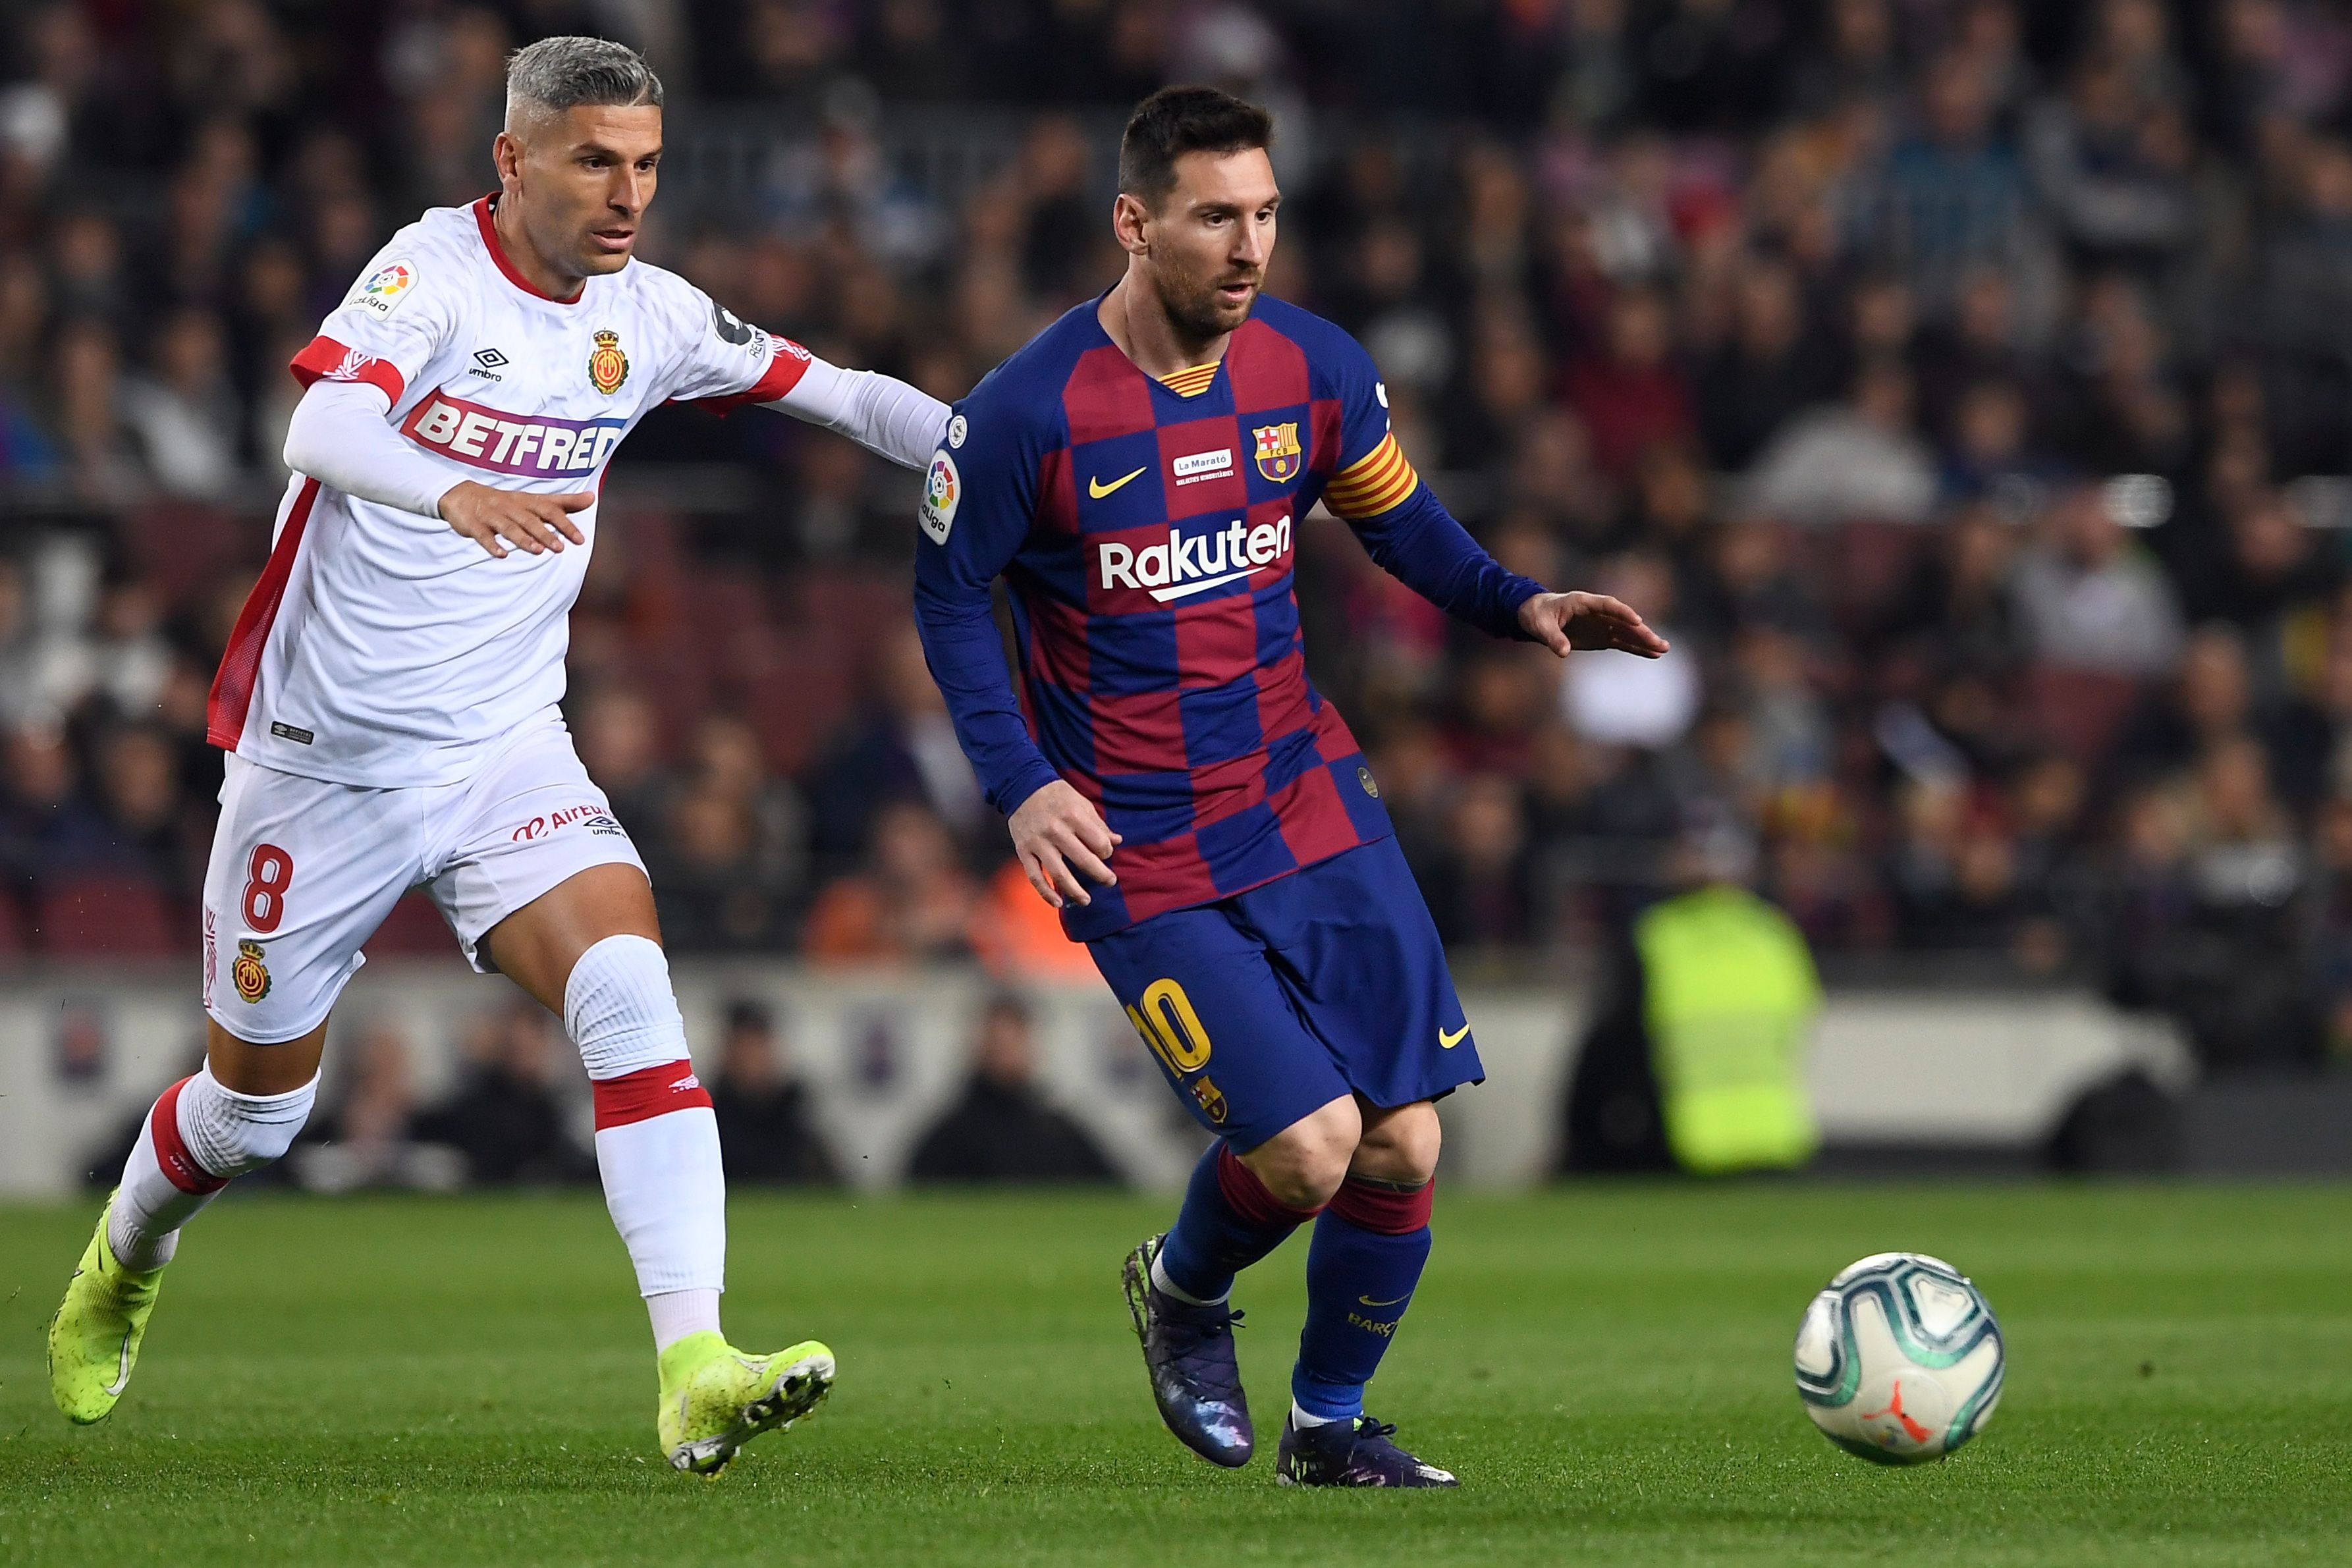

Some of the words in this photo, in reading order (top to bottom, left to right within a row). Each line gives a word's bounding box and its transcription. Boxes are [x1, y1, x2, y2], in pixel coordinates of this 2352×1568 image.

[749, 330, 765, 358] RENT
[469, 368, 502, 382] umbro
[414, 400, 622, 470] BETFRED
[1191, 455, 1226, 468] Marató
[1099, 515, 1290, 589] Rakuten
[240, 843, 294, 934] 8
